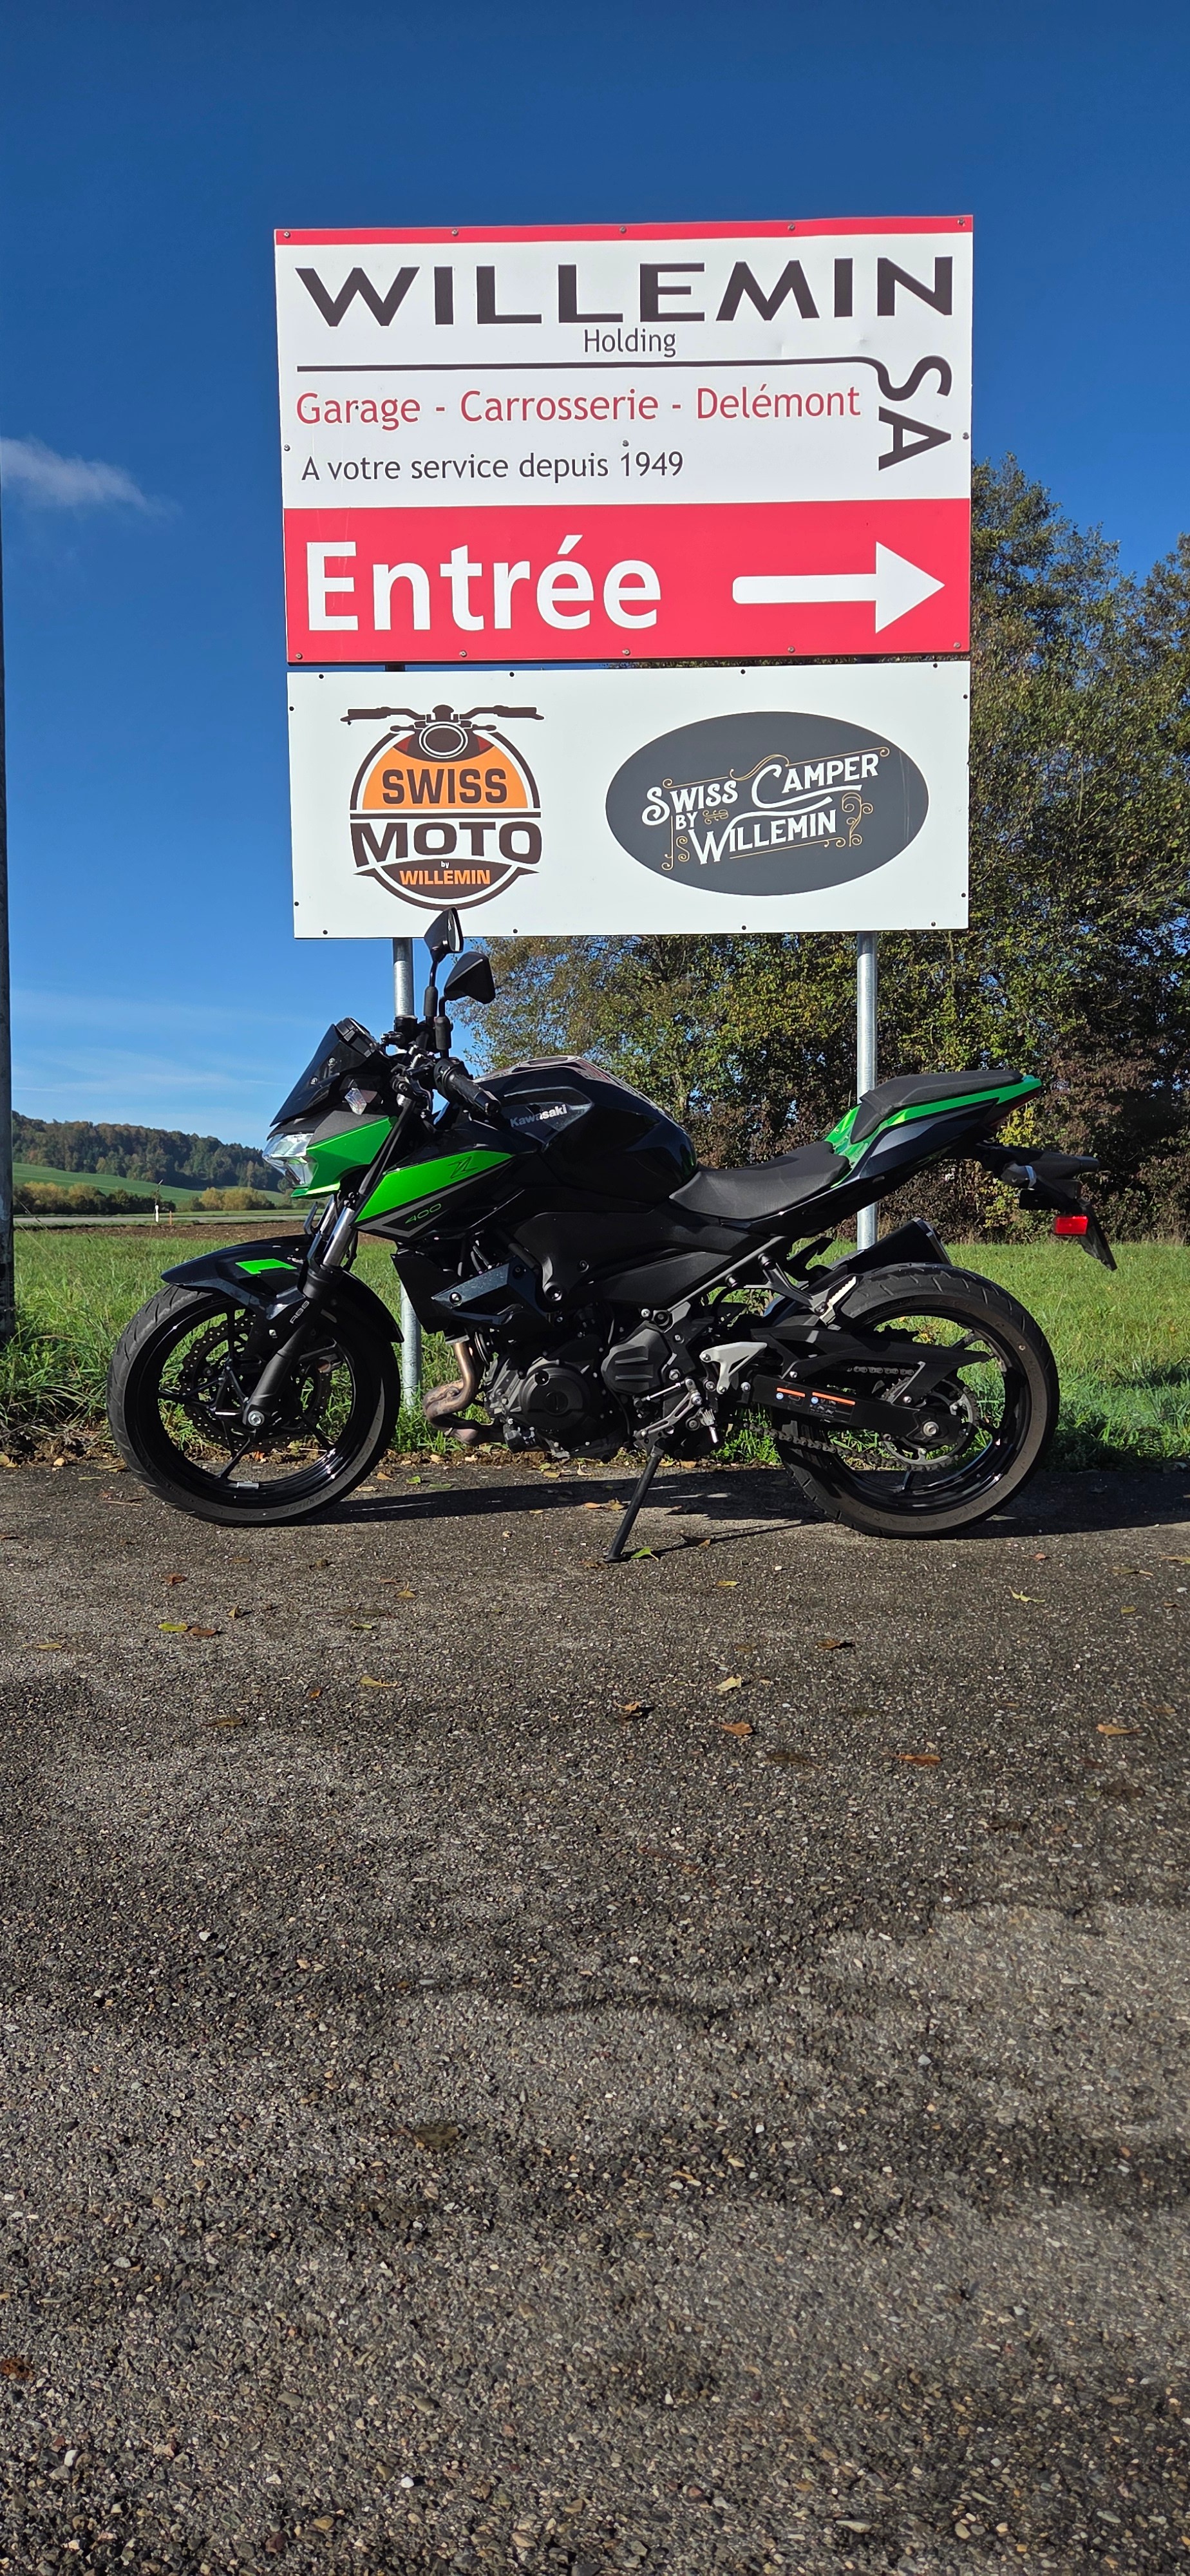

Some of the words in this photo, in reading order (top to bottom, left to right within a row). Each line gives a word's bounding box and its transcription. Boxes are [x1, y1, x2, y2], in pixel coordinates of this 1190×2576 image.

[296, 256, 953, 327] WILLEMIN
[583, 328, 677, 358] Holding
[296, 392, 420, 430] Garage
[460, 390, 659, 422] Carrosserie
[697, 384, 860, 419] Delémont
[878, 355, 952, 471] SA
[301, 456, 320, 480] A
[327, 457, 401, 480] votre
[411, 453, 509, 479] service
[519, 452, 609, 484] depuis
[621, 451, 683, 477] 1949
[307, 535, 661, 631] Entrée
[382, 768, 507, 804] SWISS
[642, 780, 739, 826] SWISS
[751, 753, 880, 809] CAMPER
[350, 821, 542, 868] MOTO
[675, 811, 698, 830] BY
[688, 796, 836, 864] WILLEMIN
[399, 869, 491, 886] WILLEMIN
[440, 860, 449, 869] by
[509, 1104, 568, 1128] Kawasaki
[404, 1202, 442, 1224] 400
[289, 1300, 310, 1324] ABS
